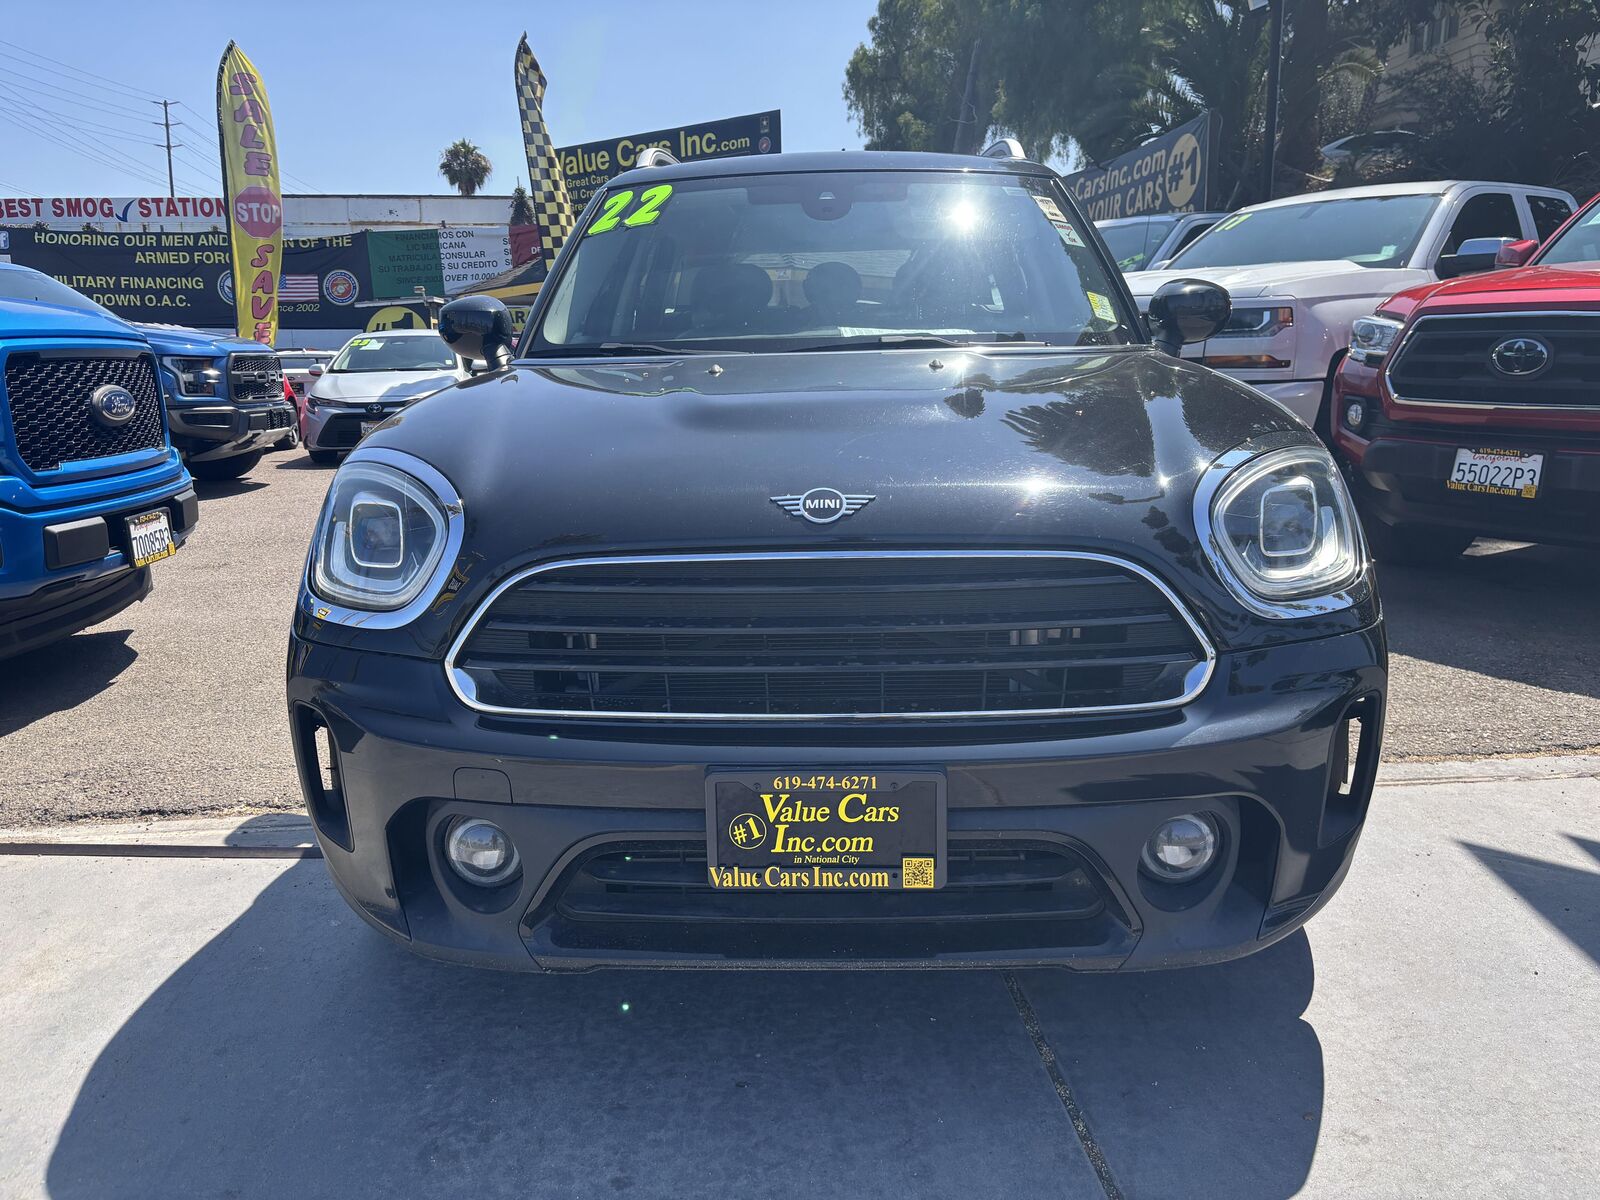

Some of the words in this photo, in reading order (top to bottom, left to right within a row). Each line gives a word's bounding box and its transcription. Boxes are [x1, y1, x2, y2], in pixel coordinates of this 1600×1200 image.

[229, 72, 272, 177] SALE
[1071, 149, 1166, 200] CarsInc.com
[1167, 146, 1198, 193] #1
[566, 176, 589, 188] Great
[590, 175, 609, 185] Cars
[580, 188, 598, 199] Cre
[52, 198, 114, 218] SMOG
[138, 198, 225, 217] STATION
[237, 202, 280, 224] STOP
[588, 184, 673, 235] 22
[1087, 194, 1121, 220] YOUR
[34, 232, 119, 246] HONORING
[124, 235, 156, 247] OUR
[161, 234, 194, 247] MEN
[198, 234, 229, 246] AND
[299, 238, 319, 248] OF
[322, 235, 352, 247] THE
[455, 230, 474, 238] CON
[135, 251, 190, 264] ARMED
[439, 250, 486, 260] CONSULAR
[448, 262, 460, 270] SU
[461, 260, 498, 269] CREDITO
[121, 276, 204, 289] FINANCING
[445, 274, 468, 282] OVER
[93, 294, 140, 306] DOWN
[144, 294, 191, 307] O.A.C.
[251, 244, 275, 344] SAVE
[296, 304, 320, 312] 2002
[1455, 462, 1537, 487] 55022P3
[1446, 480, 1466, 490] Value
[1467, 482, 1485, 492] Cars
[1486, 484, 1517, 496] Inc.com
[805, 499, 840, 509] MINI
[773, 776, 877, 790] 619-474-6271
[760, 794, 830, 823] Value
[838, 793, 899, 823] Cars
[733, 817, 763, 845] #1
[770, 824, 874, 853] Inc.com
[793, 855, 802, 864] in
[804, 855, 840, 864] National
[841, 855, 860, 865] City
[709, 866, 761, 887] Value
[764, 866, 809, 887] Cars
[812, 866, 889, 887] Inc.com
